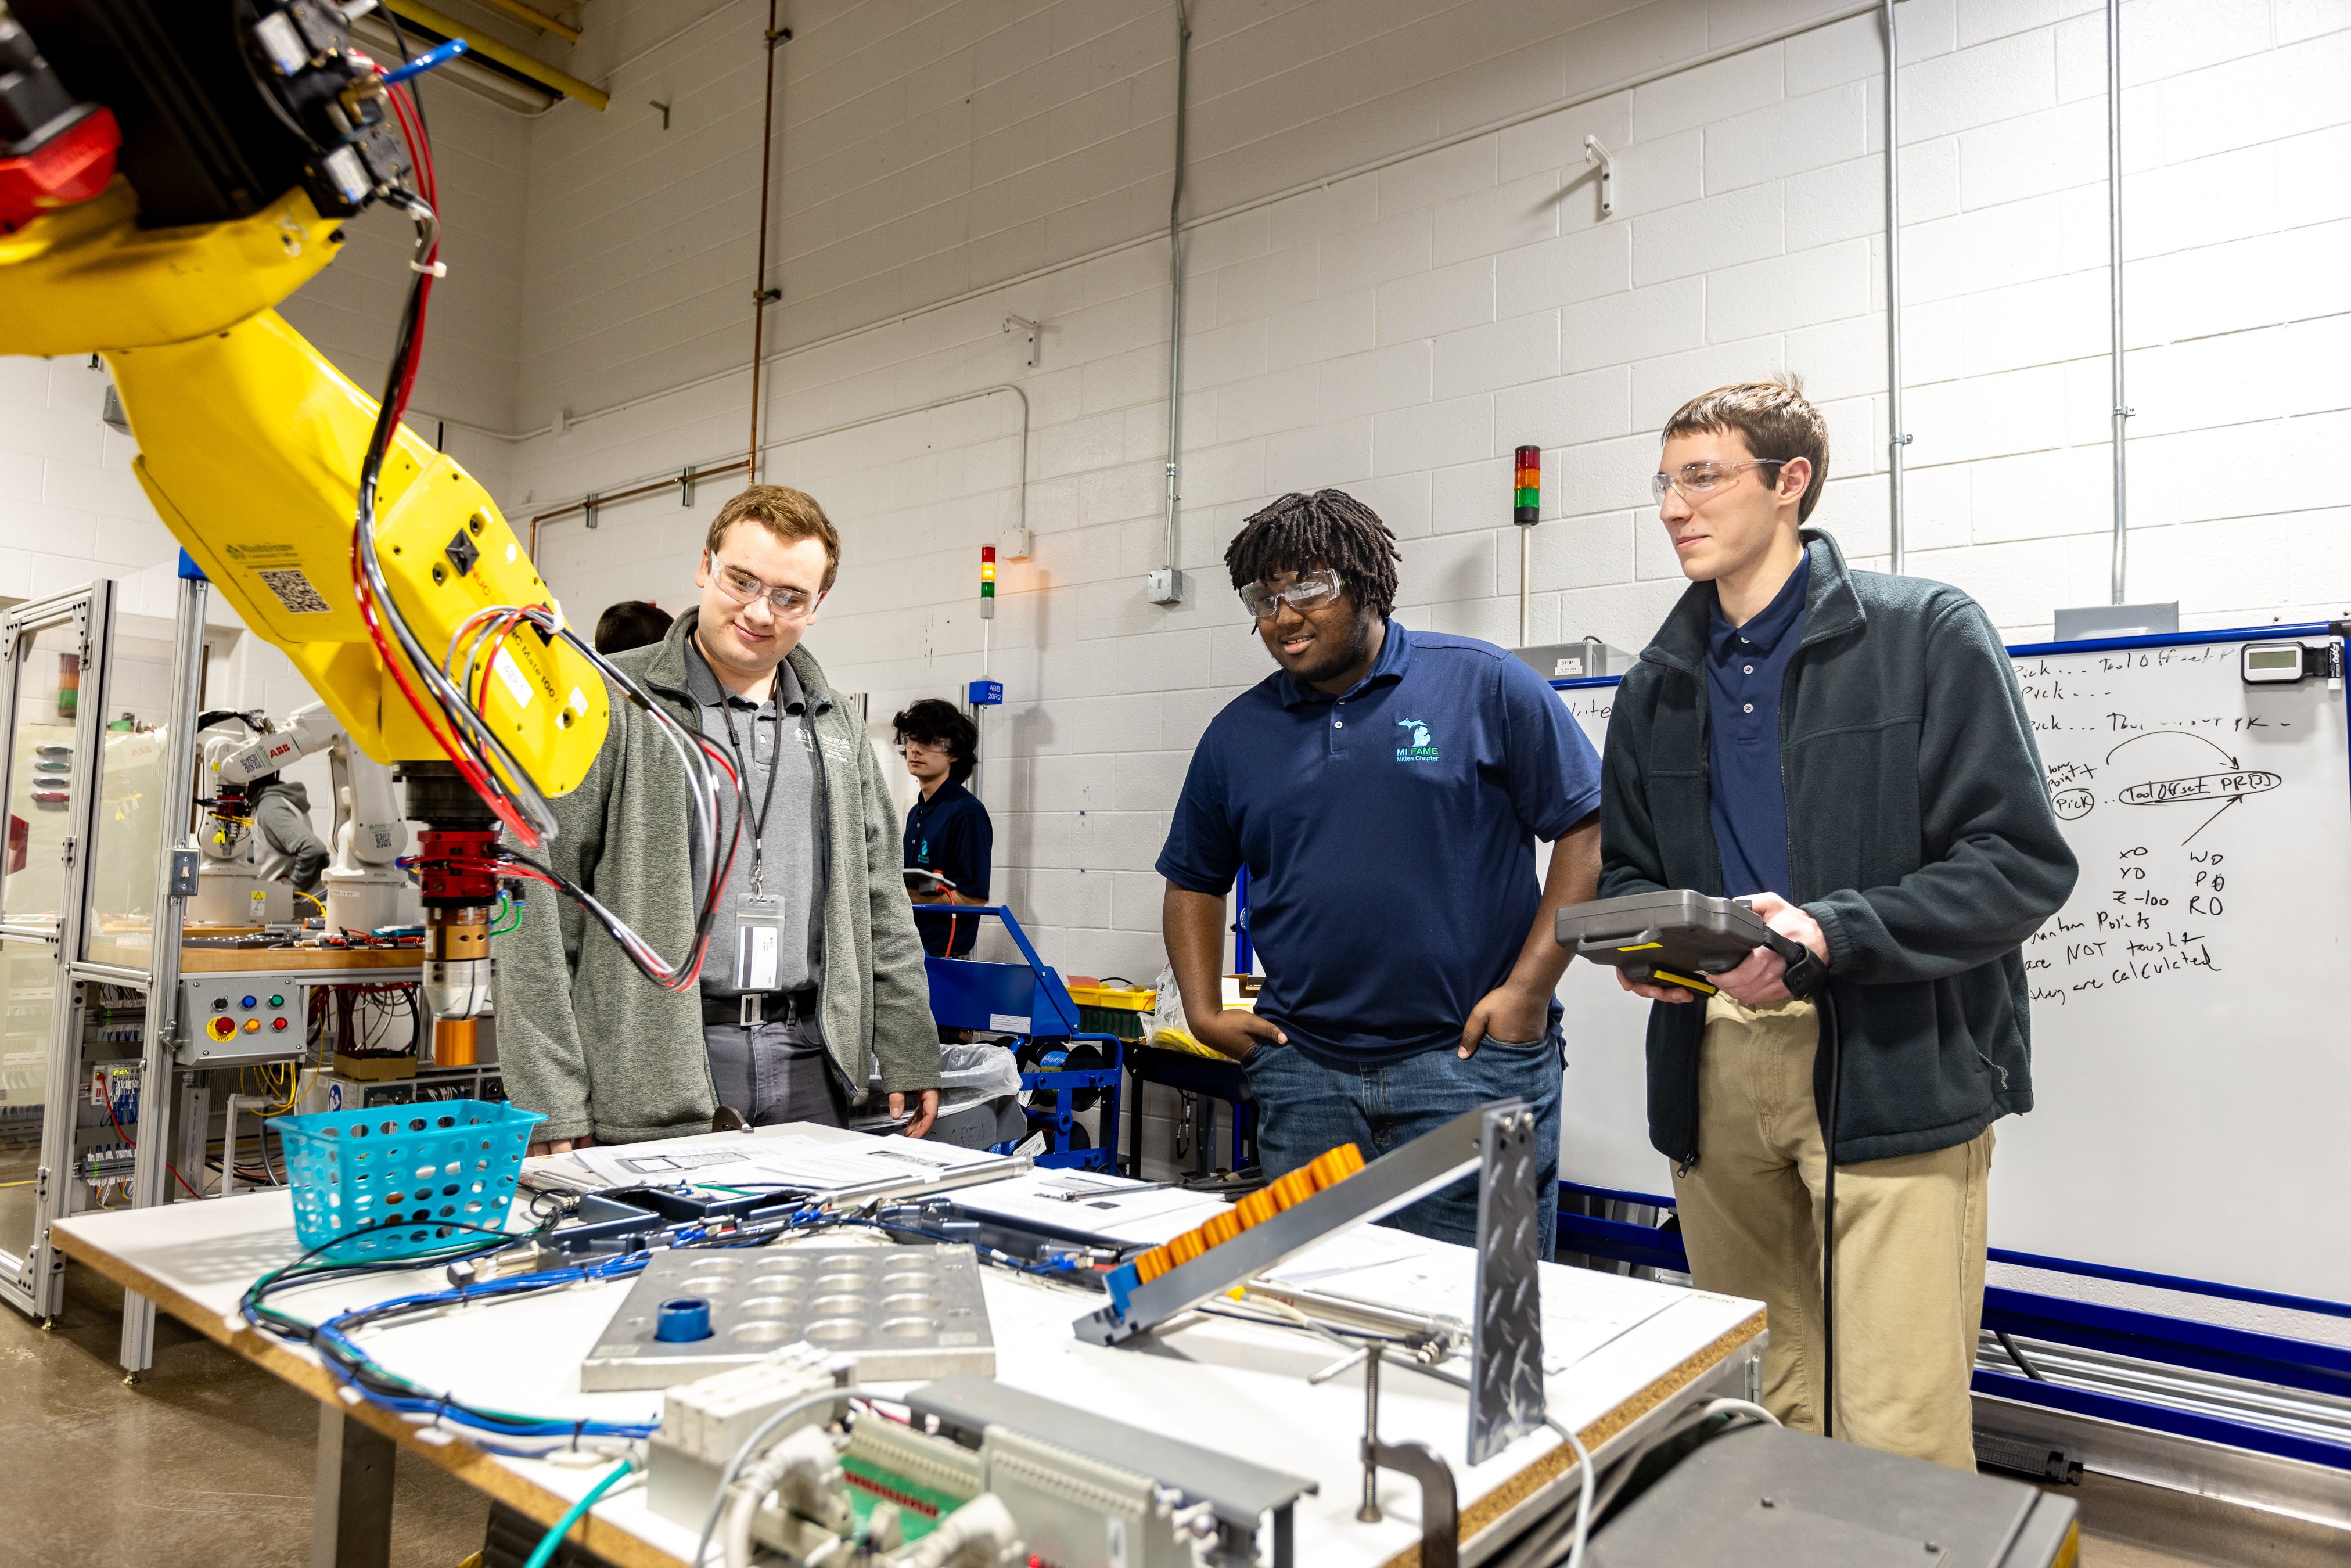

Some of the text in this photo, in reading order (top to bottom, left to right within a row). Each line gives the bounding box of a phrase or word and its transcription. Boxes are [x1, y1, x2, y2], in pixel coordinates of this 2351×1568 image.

[509, 628, 523, 647] RC
[522, 646, 541, 677] Mate
[2098, 652, 2131, 673] Tool
[2330, 643, 2340, 663] EXPO
[988, 693, 1002, 701] 20R2
[989, 685, 1001, 693] ABB
[1572, 699, 1611, 718] rite
[2030, 715, 2062, 731] ick
[269, 743, 291, 759] ABB
[1397, 747, 1439, 756] MI FAME
[2056, 796, 2092, 812] Pick
[2126, 781, 2154, 801] Tool
[2025, 959, 2051, 970] are
[2066, 941, 2107, 965] NOT
[2029, 987, 2066, 1005] they
[2072, 979, 2104, 991] are
[948, 1124, 985, 1148] AREA
